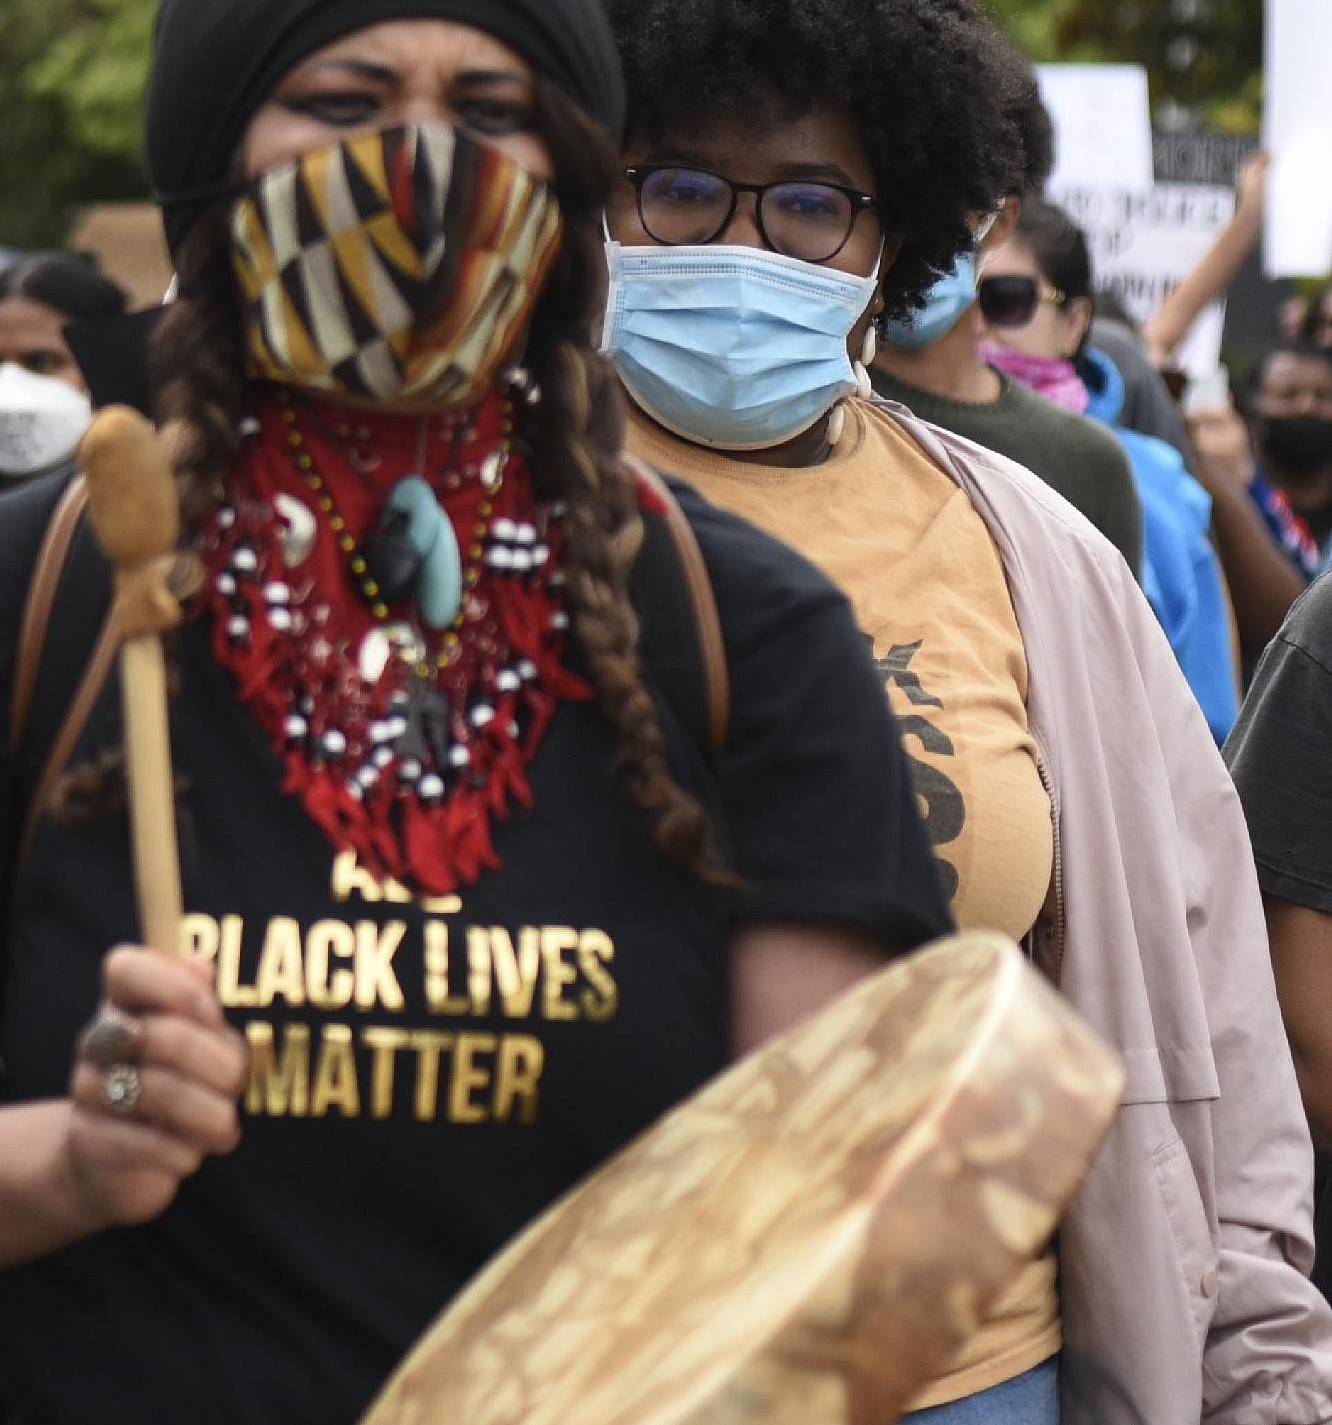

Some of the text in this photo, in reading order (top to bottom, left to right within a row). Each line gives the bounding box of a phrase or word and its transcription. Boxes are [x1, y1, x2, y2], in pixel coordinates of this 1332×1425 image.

[180, 913, 618, 1021] BLACK LIVES
[245, 1021, 544, 1125] MATTER
